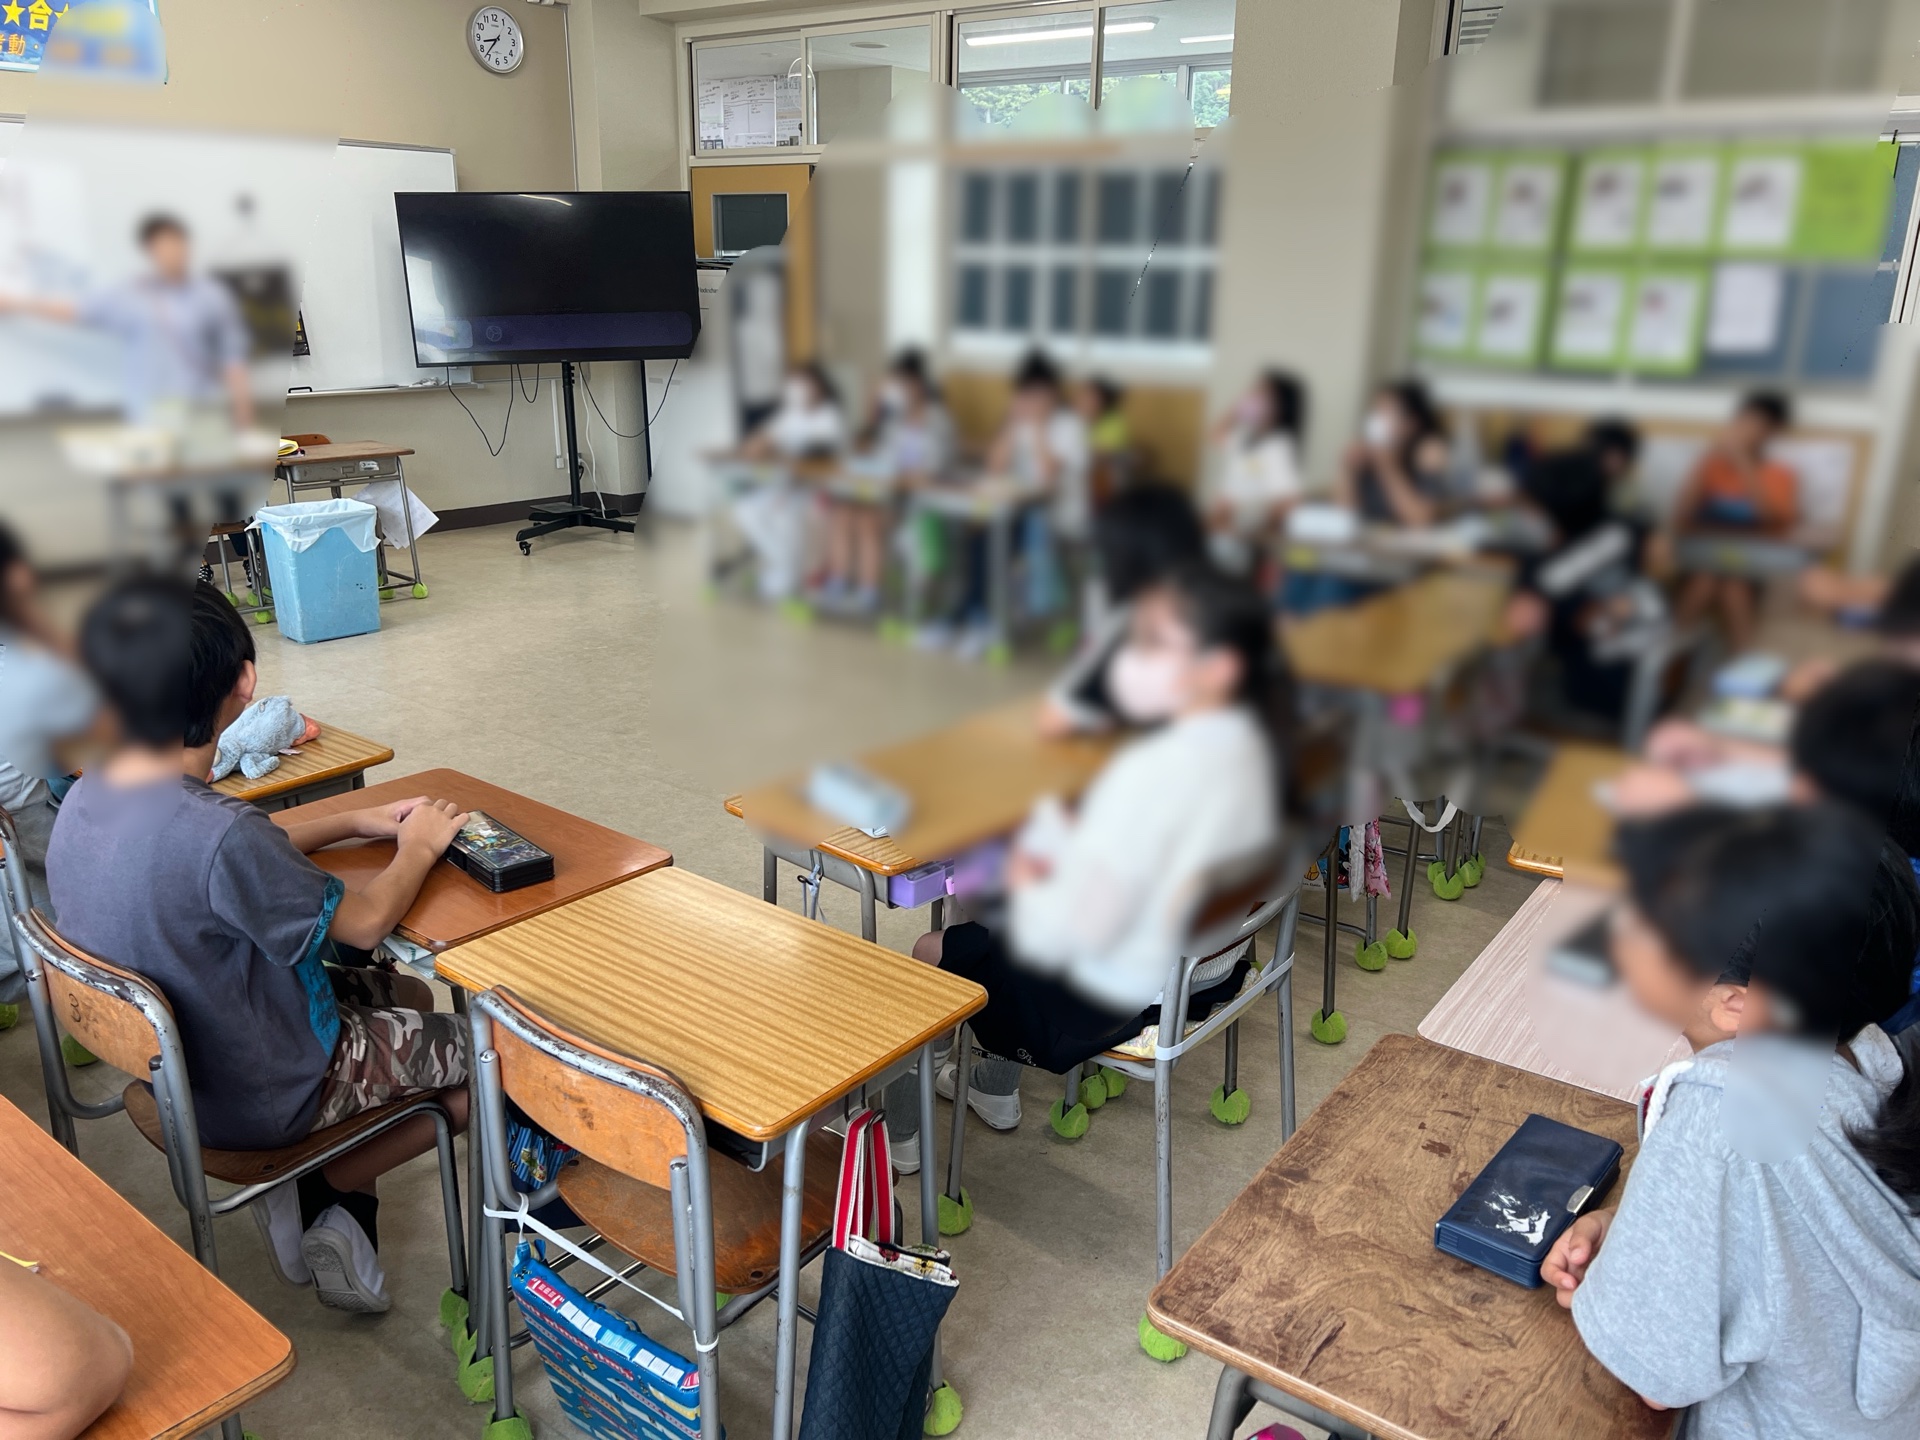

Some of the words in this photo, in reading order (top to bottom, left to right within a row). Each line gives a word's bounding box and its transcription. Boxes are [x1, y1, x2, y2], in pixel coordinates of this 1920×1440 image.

[483, 15, 489, 23] 11
[491, 13, 498, 22] 12
[501, 18, 505, 26] 1
[477, 22, 484, 31] 10
[507, 26, 512, 35] 2
[476, 33, 481, 41] 9
[511, 38, 516, 47] 3
[480, 44, 485, 53] 8
[487, 53, 491, 61] 7
[508, 49, 513, 57] 4
[495, 57, 500, 66] 6
[503, 56, 508, 64] 5
